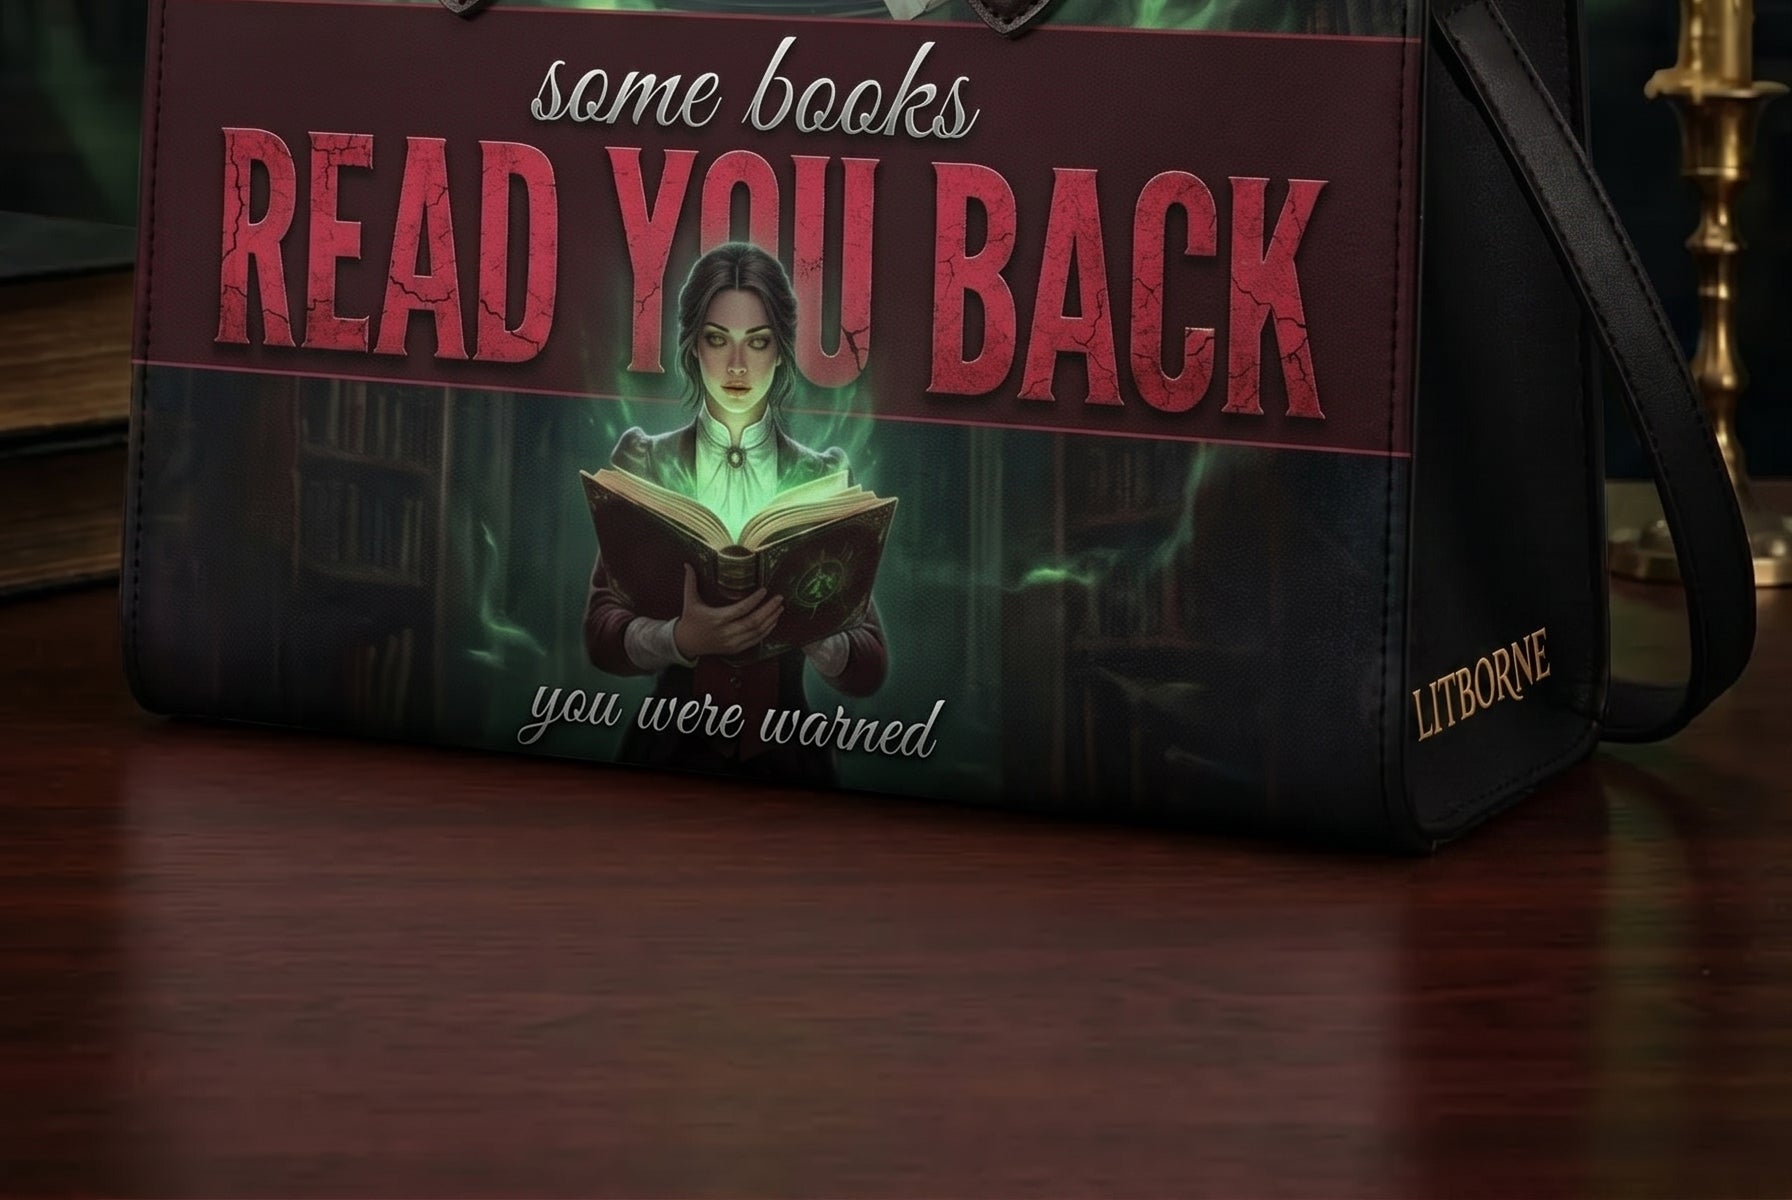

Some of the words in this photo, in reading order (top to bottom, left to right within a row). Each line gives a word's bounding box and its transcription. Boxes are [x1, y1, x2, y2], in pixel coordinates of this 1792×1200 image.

[530, 59, 722, 128] some
[741, 36, 981, 140] books
[213, 126, 559, 363] READ
[926, 161, 1329, 420] BACK
[517, 684, 624, 746] you
[637, 693, 745, 739] were
[759, 699, 946, 759] warned
[1412, 626, 1551, 743] LITBORNE
